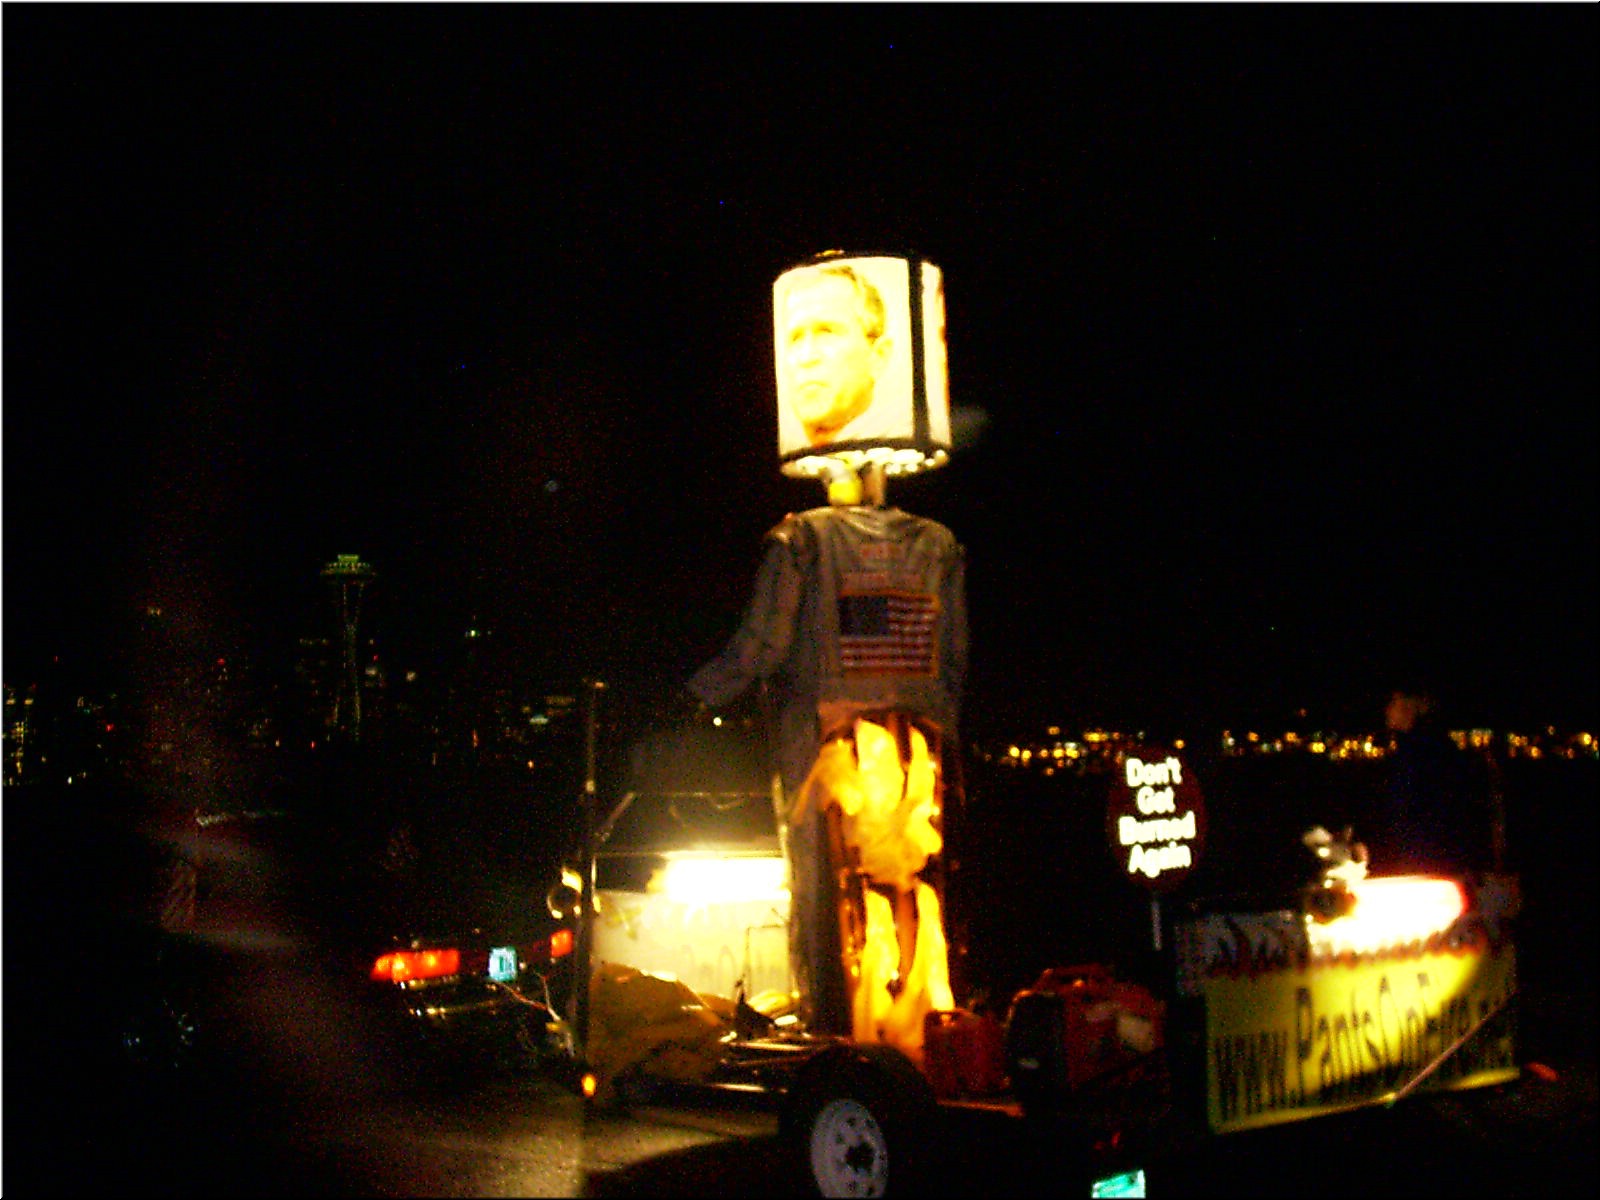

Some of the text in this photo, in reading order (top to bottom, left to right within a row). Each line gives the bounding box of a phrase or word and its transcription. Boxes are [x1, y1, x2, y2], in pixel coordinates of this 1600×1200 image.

[1126, 757, 1183, 787] Don't
[1137, 786, 1176, 815] Get
[1127, 841, 1193, 879] Again
